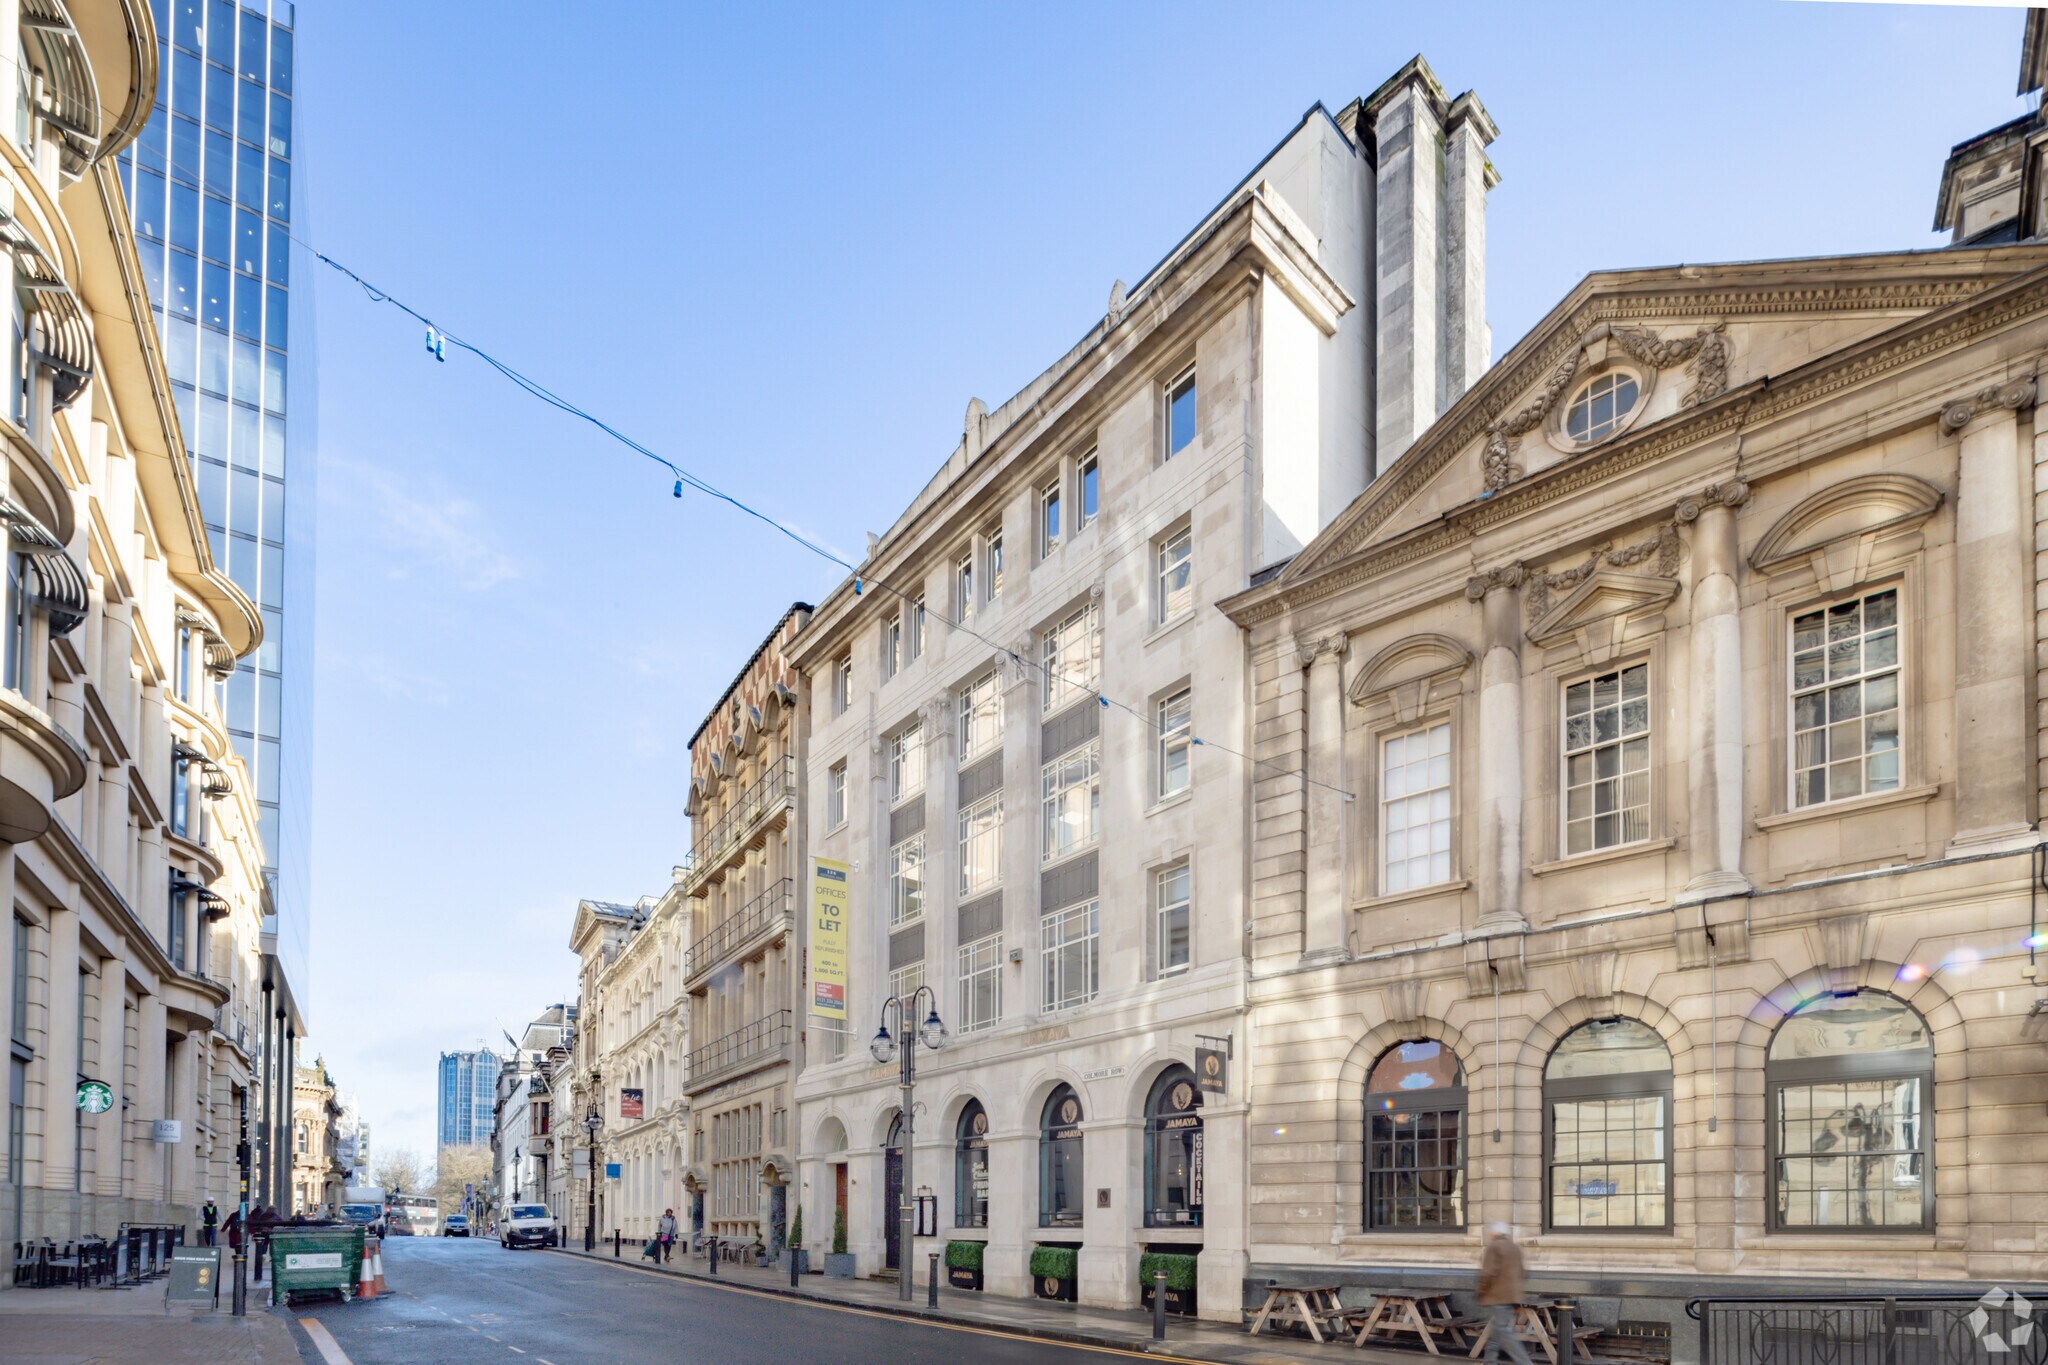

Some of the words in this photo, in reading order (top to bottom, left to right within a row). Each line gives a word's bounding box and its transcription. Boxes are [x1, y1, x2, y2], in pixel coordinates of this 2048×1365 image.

[816, 886, 846, 899] OFFICES
[822, 903, 840, 916] TO
[818, 918, 842, 932] LET
[1084, 1069, 1108, 1080] COLMORE
[1201, 1078, 1223, 1087] JAMAYA
[1166, 1117, 1198, 1129] JAMAYA
[1056, 1130, 1082, 1139] JAMAYA
[1147, 1290, 1179, 1302] JAAYA
